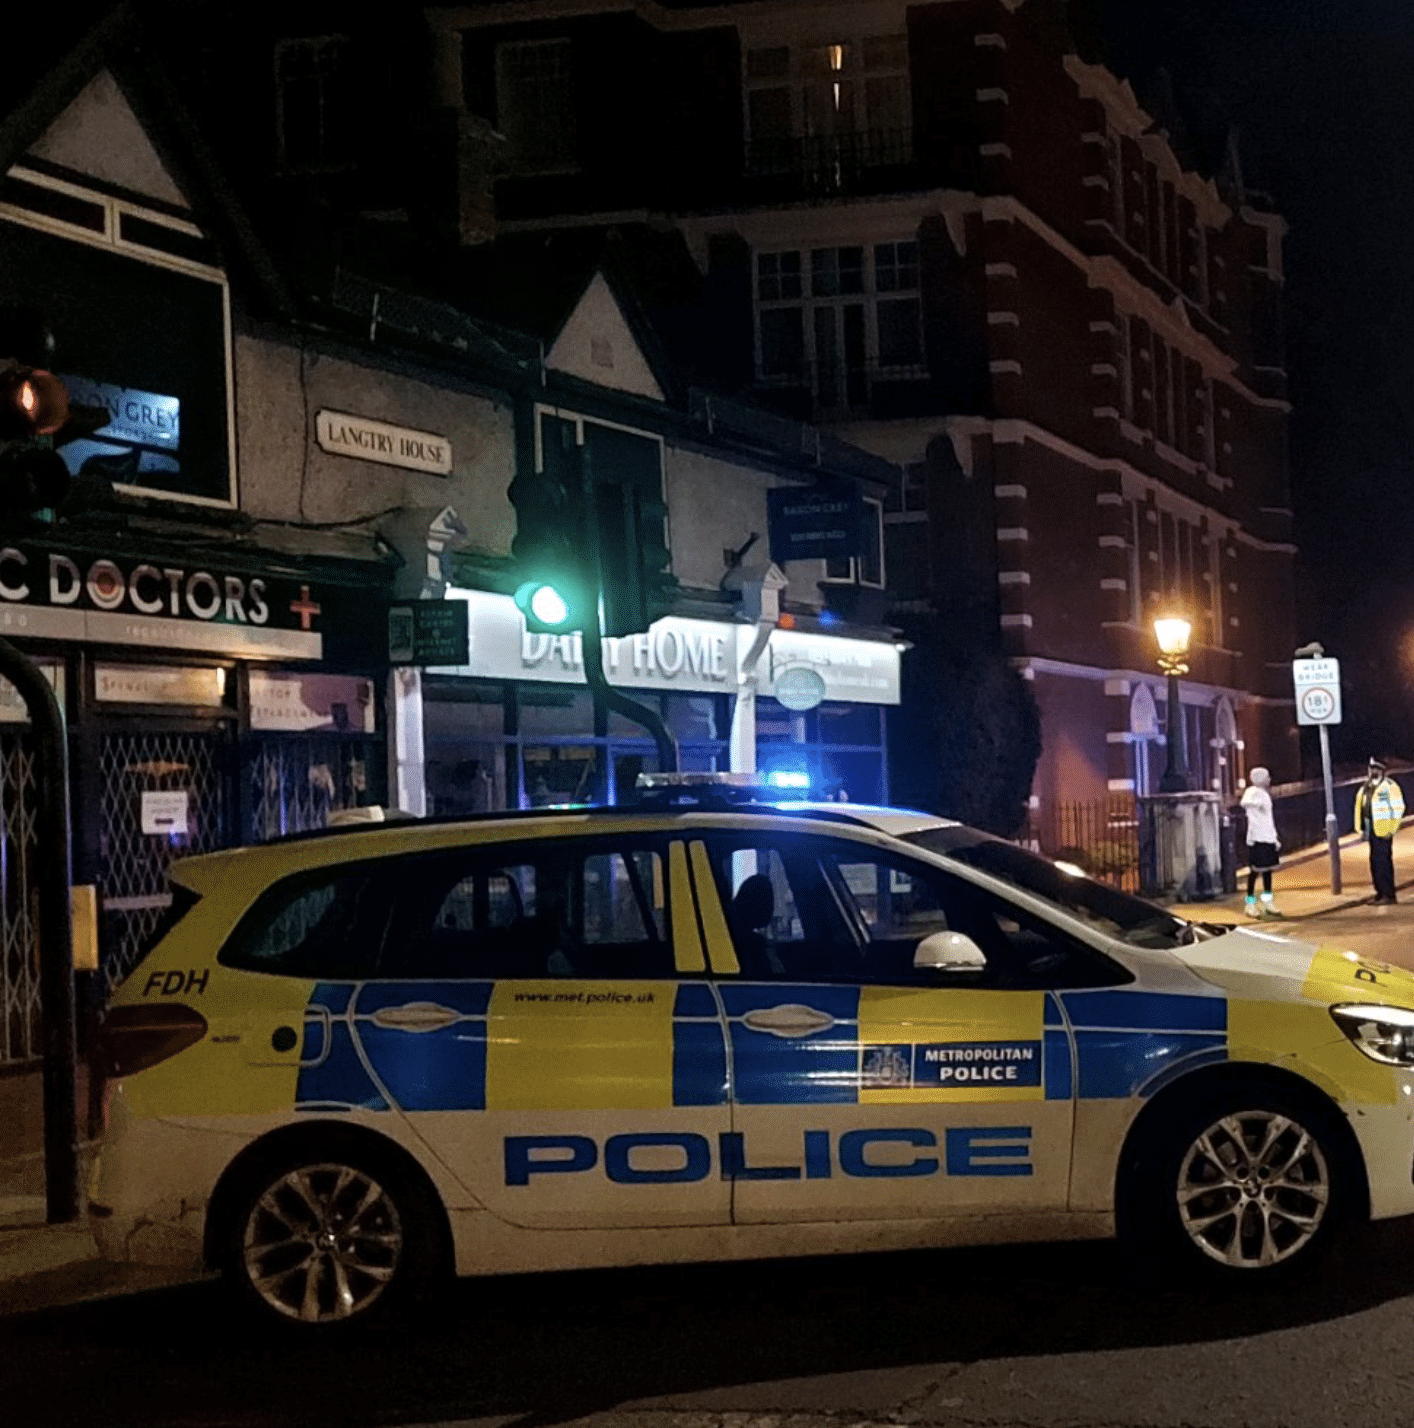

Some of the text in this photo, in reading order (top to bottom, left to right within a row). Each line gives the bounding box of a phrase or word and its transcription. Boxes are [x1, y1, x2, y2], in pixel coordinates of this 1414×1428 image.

[124, 400, 178, 428] GREY
[328, 422, 444, 463] LANGTRY HOUSE
[49, 553, 269, 624] DOCTORS
[521, 630, 729, 676] DAIY HOME
[142, 968, 210, 997] FDH
[514, 991, 655, 1005] www.met.police.uk
[925, 1048, 1033, 1062] METROPOLITAN
[940, 1066, 1018, 1081] POLICE
[504, 1125, 1033, 1187] POLICE
